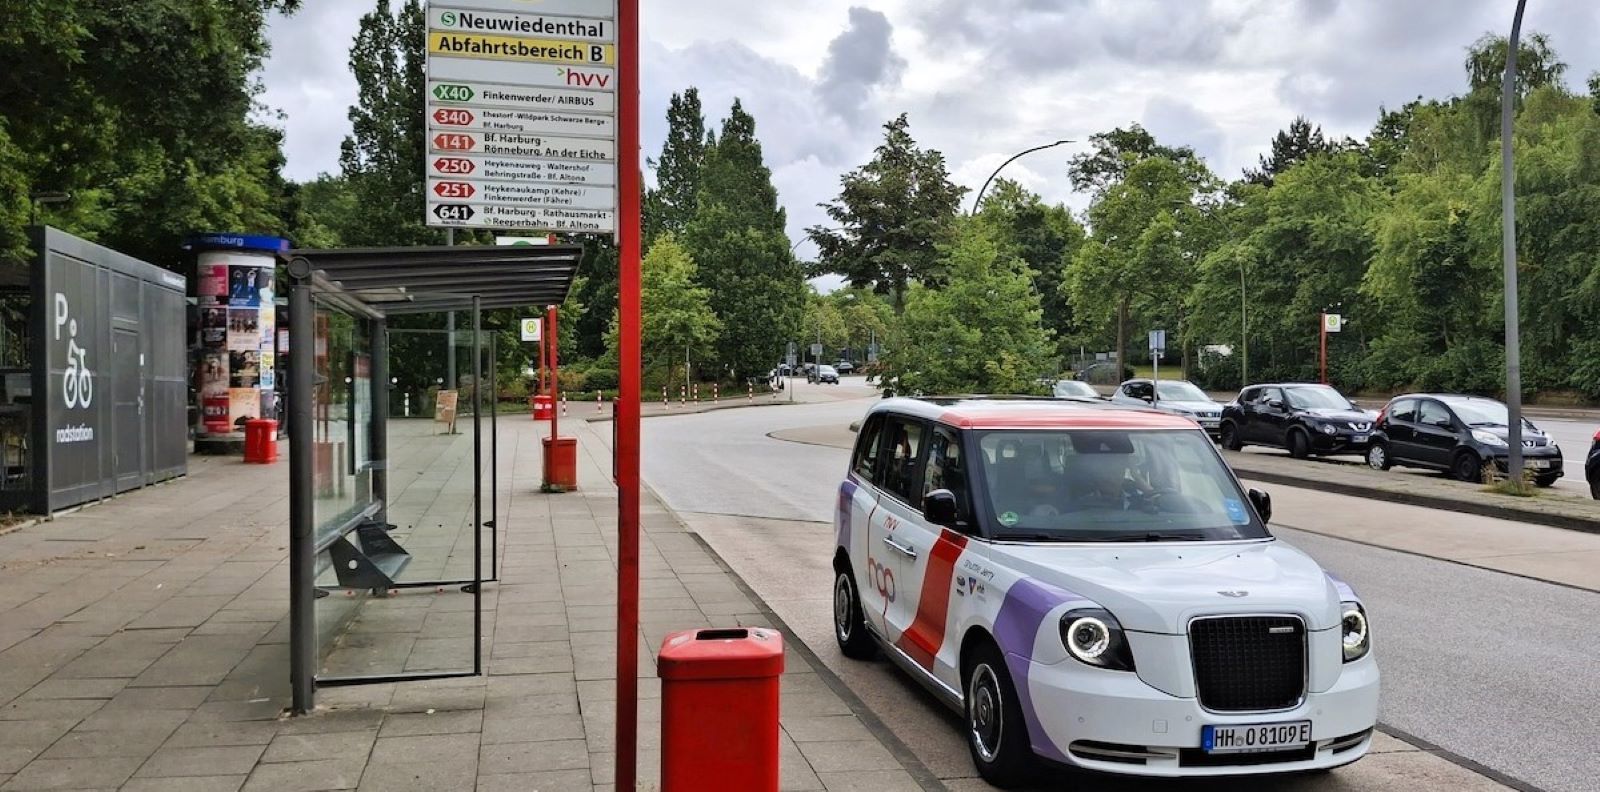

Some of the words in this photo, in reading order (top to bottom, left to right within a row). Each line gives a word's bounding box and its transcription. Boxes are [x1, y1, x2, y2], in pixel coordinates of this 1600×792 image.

[460, 13, 603, 37] Neuwiedenthal
[439, 37, 583, 60] Abfahrtsbereich
[591, 46, 603, 61] B
[566, 68, 609, 88] hvv
[439, 84, 469, 100] X40
[483, 90, 555, 104] Finkenwerder/
[557, 93, 594, 106] AIRBUS
[439, 109, 468, 124] 340
[483, 111, 513, 120] Ehestorf
[584, 117, 605, 126] Berge
[494, 122, 523, 132] Harburg
[441, 135, 469, 149] 141
[484, 132, 497, 142] Bf.
[499, 133, 541, 146] Harburg
[545, 148, 560, 157] An
[561, 148, 578, 158] der
[580, 149, 606, 159] Eiche
[440, 159, 471, 173] 250
[484, 160, 541, 171] Heykenauweg
[547, 163, 590, 172] Waltershof
[484, 169, 541, 180] Behringstraße
[547, 172, 558, 181] Bf.
[559, 173, 586, 182] Altona
[440, 183, 470, 197] 251
[484, 184, 550, 196] Heykenaukamp
[551, 188, 582, 197] (Kehre)
[484, 193, 542, 203] Finkenwerder
[543, 196, 572, 205] (Fähre)
[439, 206, 468, 219] 641
[483, 207, 495, 215] Bf.
[497, 207, 536, 218] Harburg
[543, 208, 607, 220] Rathausmarkt
[492, 217, 549, 228] Reeperbahn
[556, 220, 567, 228] Bf.
[569, 221, 599, 230] Altona
[55, 293, 69, 341] P
[56, 423, 93, 443] radstation
[1215, 729, 1235, 747] HH
[1259, 725, 1297, 745] 8109
[1300, 724, 1309, 742] E
